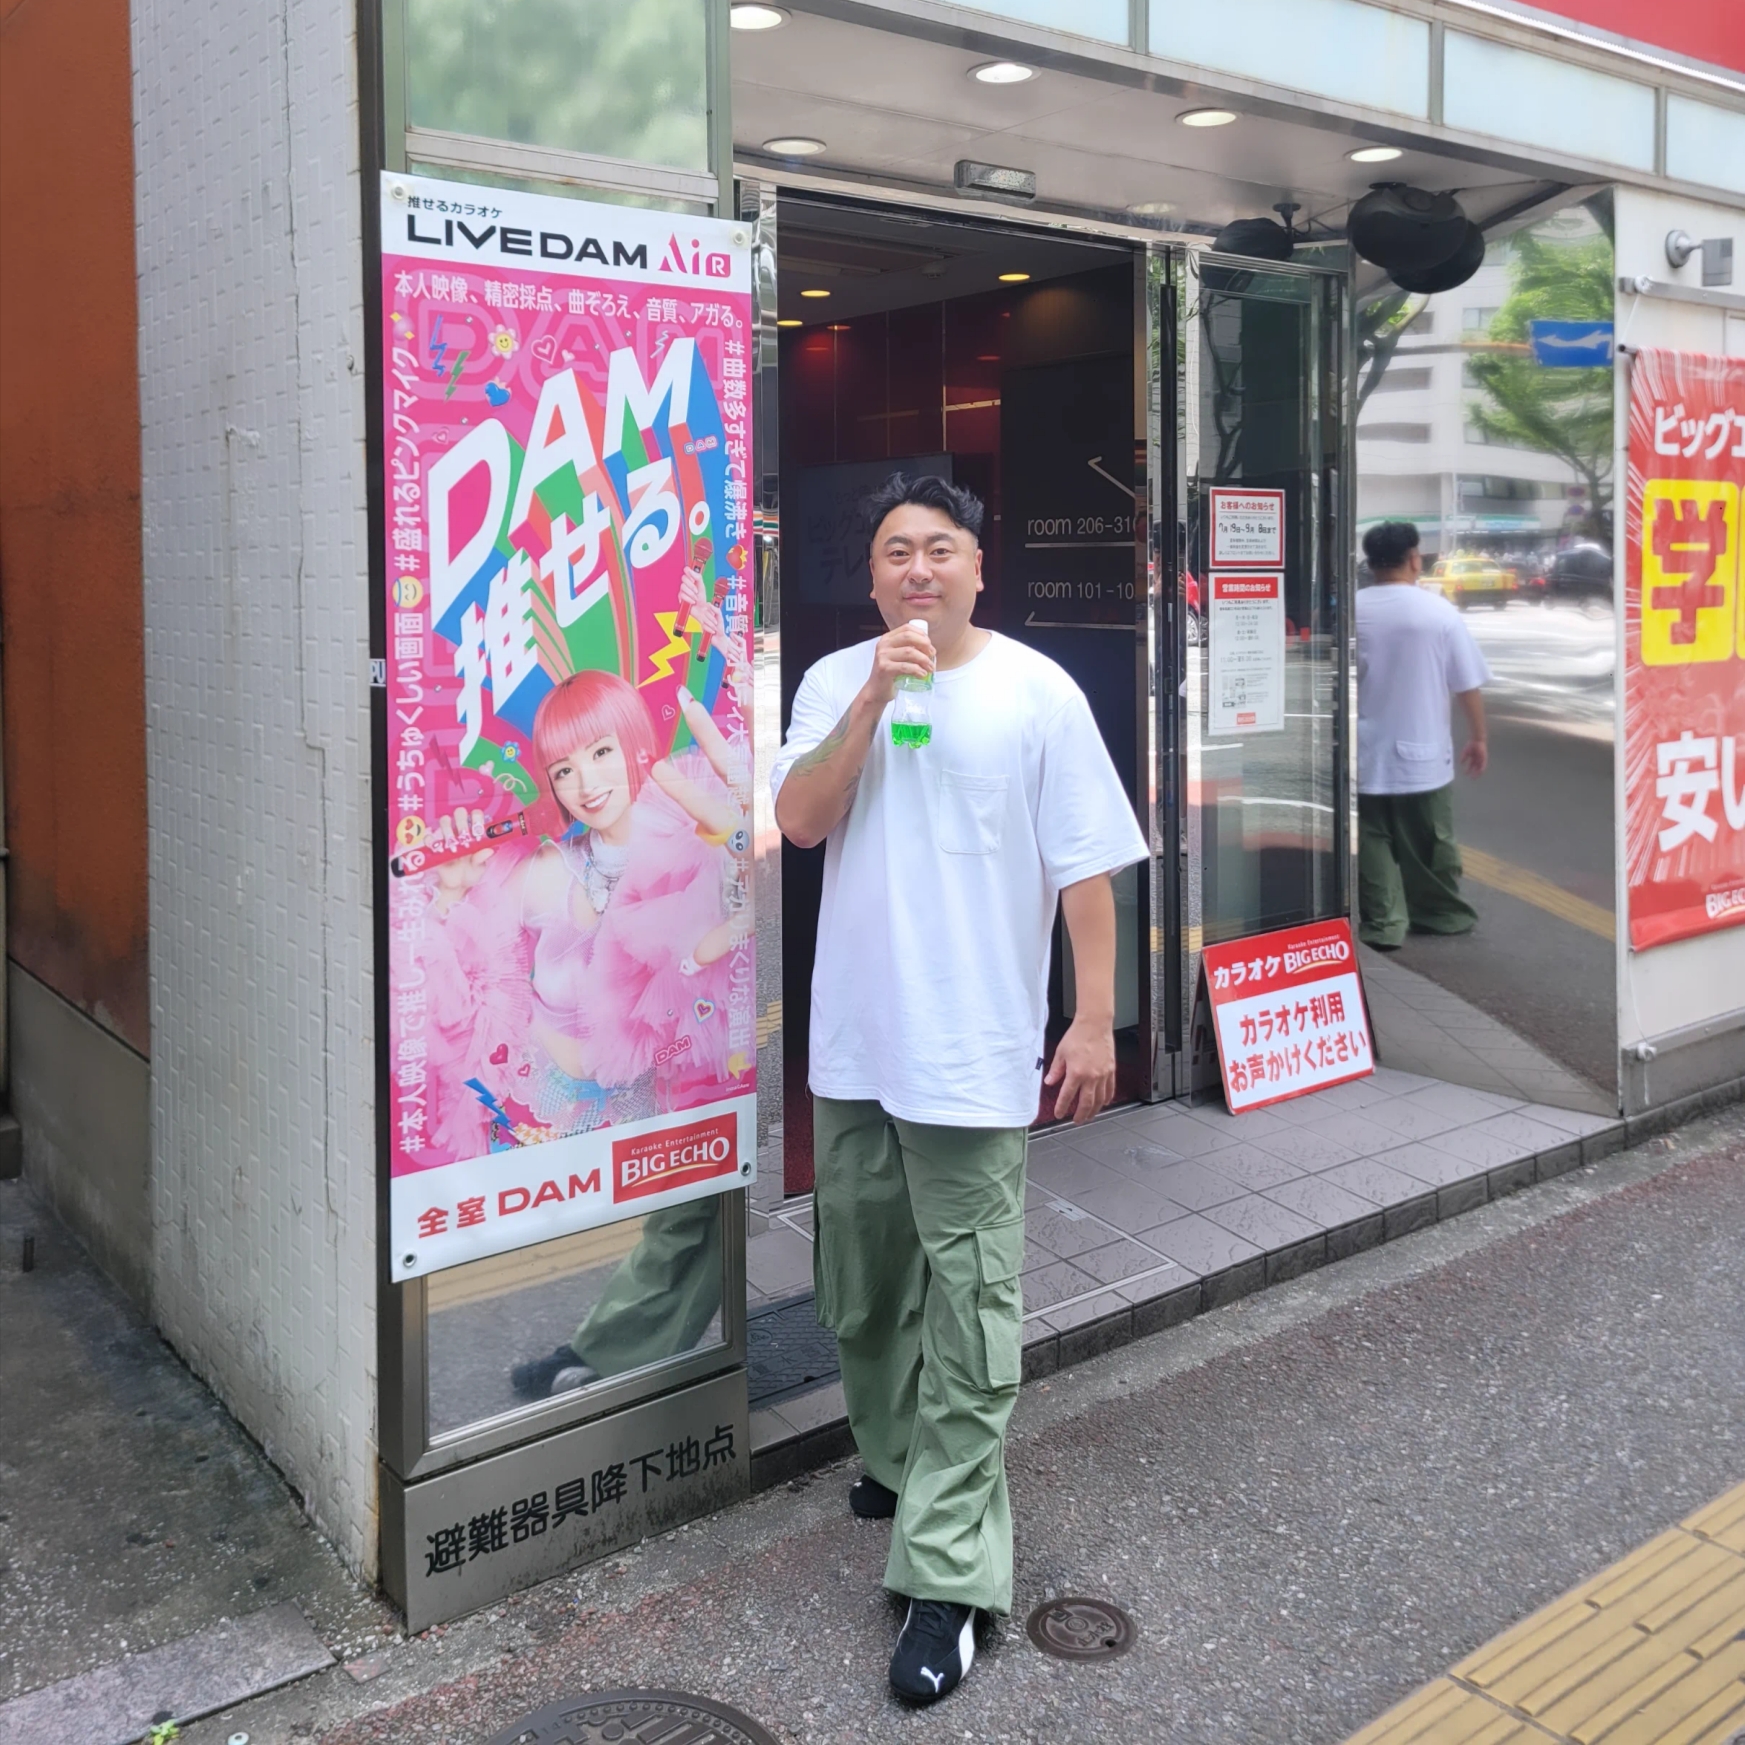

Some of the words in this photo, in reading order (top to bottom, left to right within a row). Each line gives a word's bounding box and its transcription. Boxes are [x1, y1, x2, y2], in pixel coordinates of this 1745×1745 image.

[407, 195, 503, 219] 推せるカラオケ
[540, 232, 648, 270] DAM
[394, 270, 743, 329] 本人映像、精密採点、曲ぞろえ、音質、アガる。
[391, 347, 422, 571] #盛れるピンクマイク
[428, 337, 696, 631] DAM
[1027, 517, 1071, 535] room
[1220, 501, 1275, 511] お客様へのお知らせ
[1027, 579, 1071, 598] room
[1651, 499, 1727, 645] 学
[394, 613, 425, 810] #うちゅくしい画面
[1214, 955, 1280, 989] カラオケ
[1283, 949, 1311, 974] BIG
[1311, 940, 1350, 961] ECHO
[1239, 991, 1345, 1046] カラオケ利用
[655, 1035, 691, 1066] DAM
[1229, 1030, 1367, 1093] お声かけください
[621, 1154, 665, 1188] BIG
[670, 1137, 730, 1167] ECHO
[631, 1143, 662, 1156] Karaoke
[665, 1128, 719, 1148] Entertainment
[417, 1196, 487, 1239] 全室
[499, 1168, 601, 1216] DAM
[425, 1424, 737, 1577] 避難器具降下地点
